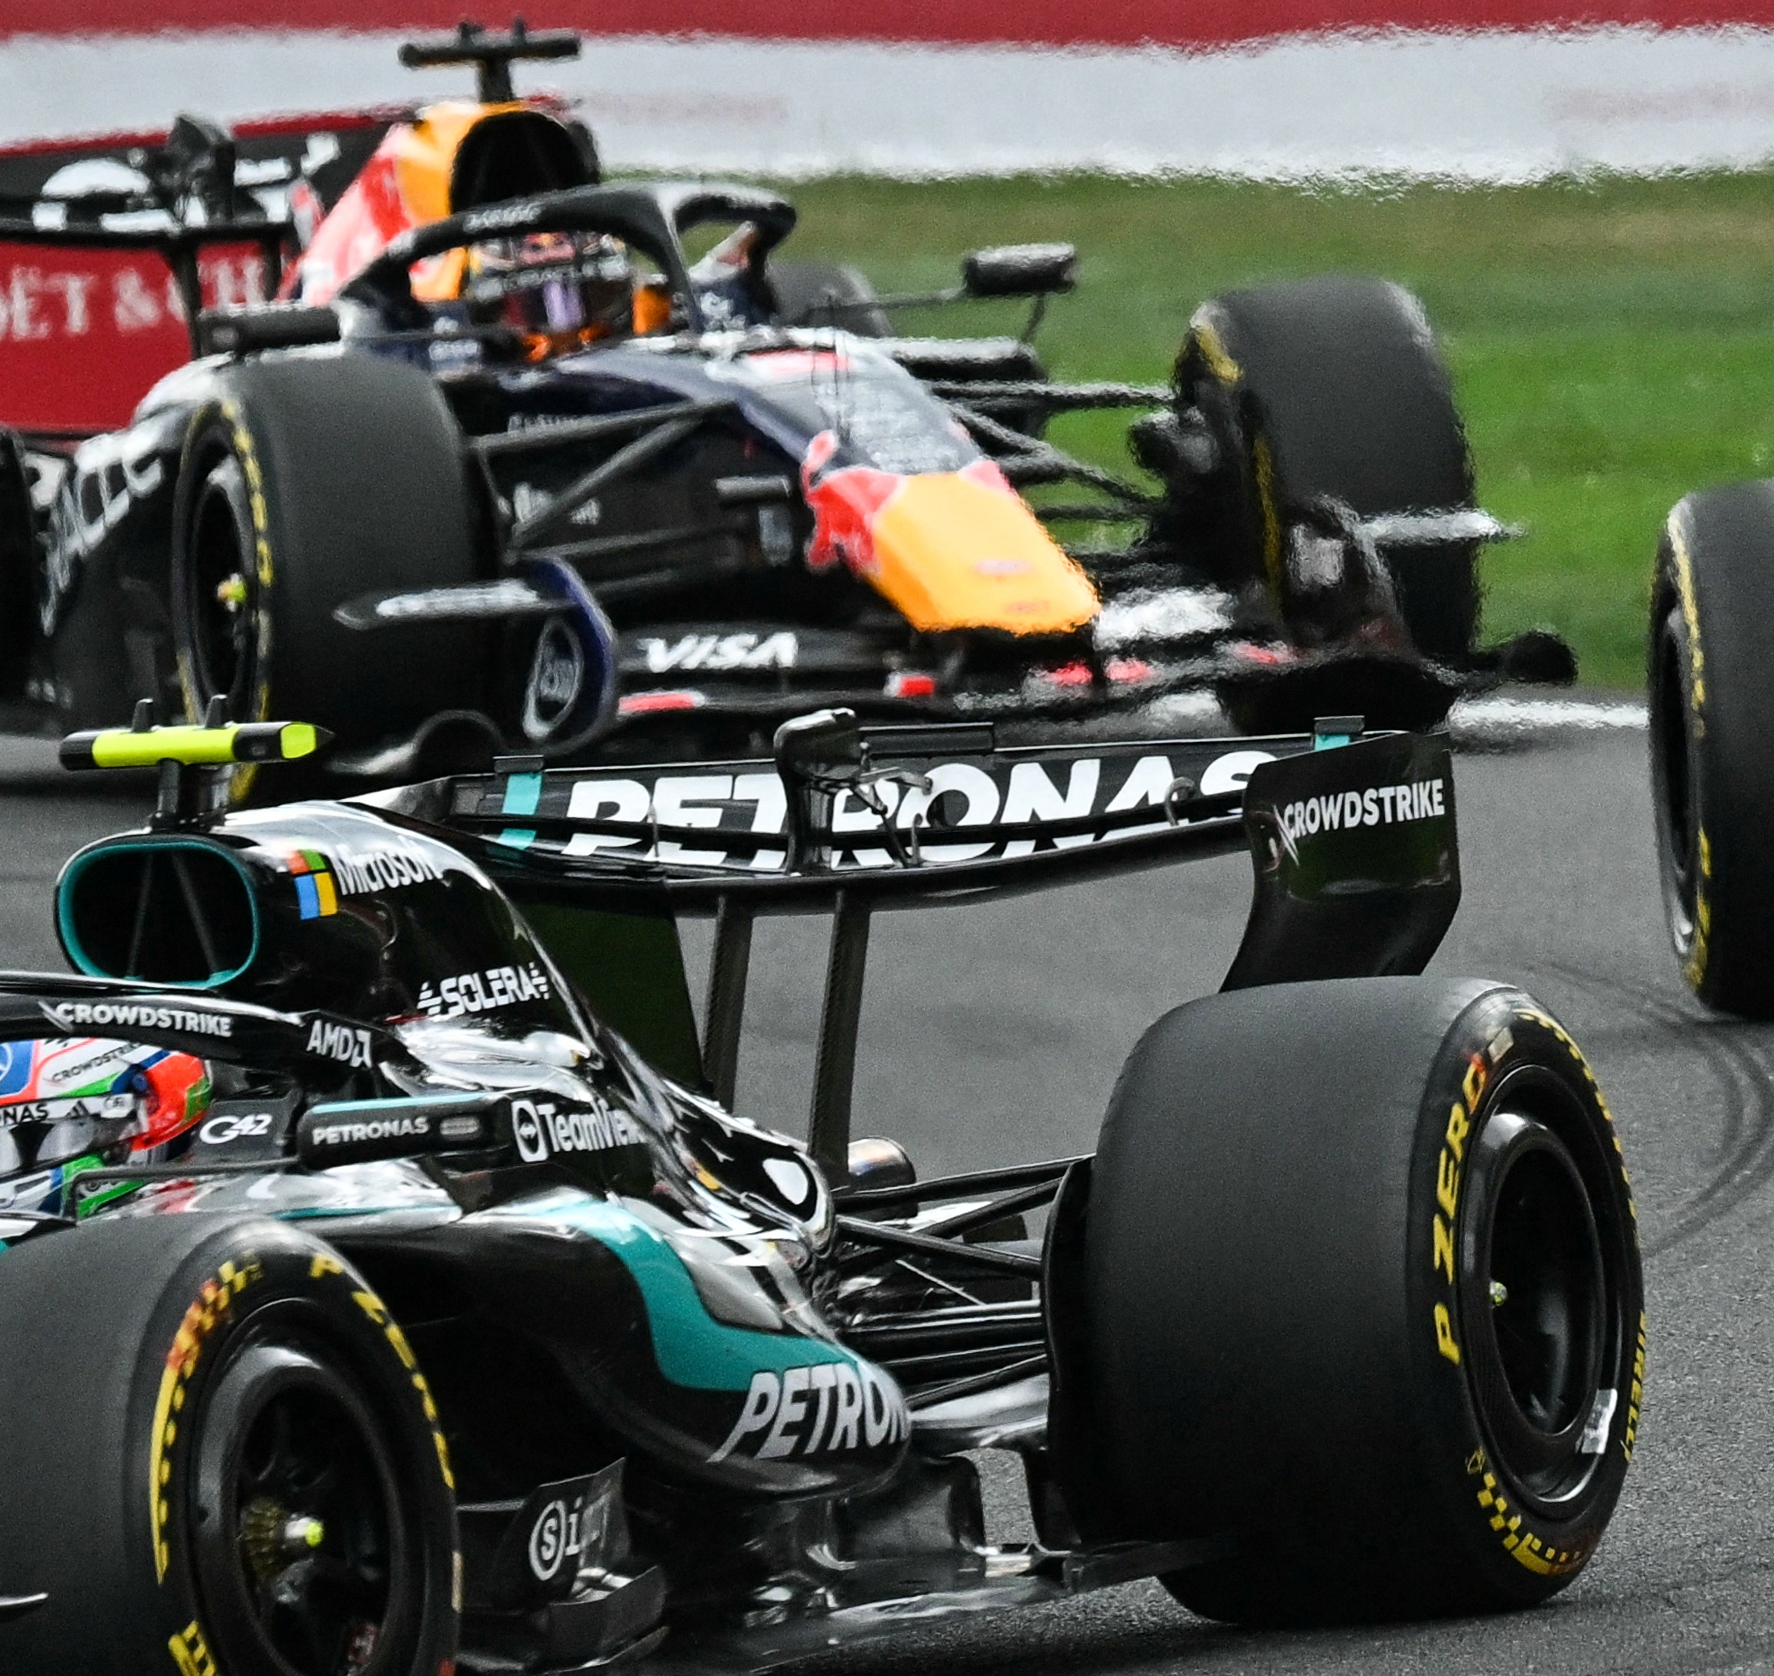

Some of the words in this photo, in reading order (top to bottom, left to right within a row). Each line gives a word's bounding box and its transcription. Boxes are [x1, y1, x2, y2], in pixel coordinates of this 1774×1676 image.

[638, 632, 799, 674] VISA
[1283, 778, 1445, 841] CROWDSTRIKE
[439, 964, 542, 1017] SOLERA
[55, 1002, 233, 1038] CROWDSTRIKE
[306, 1018, 355, 1061] AMD
[199, 1113, 273, 1145] G42
[312, 1116, 429, 1146] PETRONAS
[1433, 1052, 1488, 1286] ZERO
